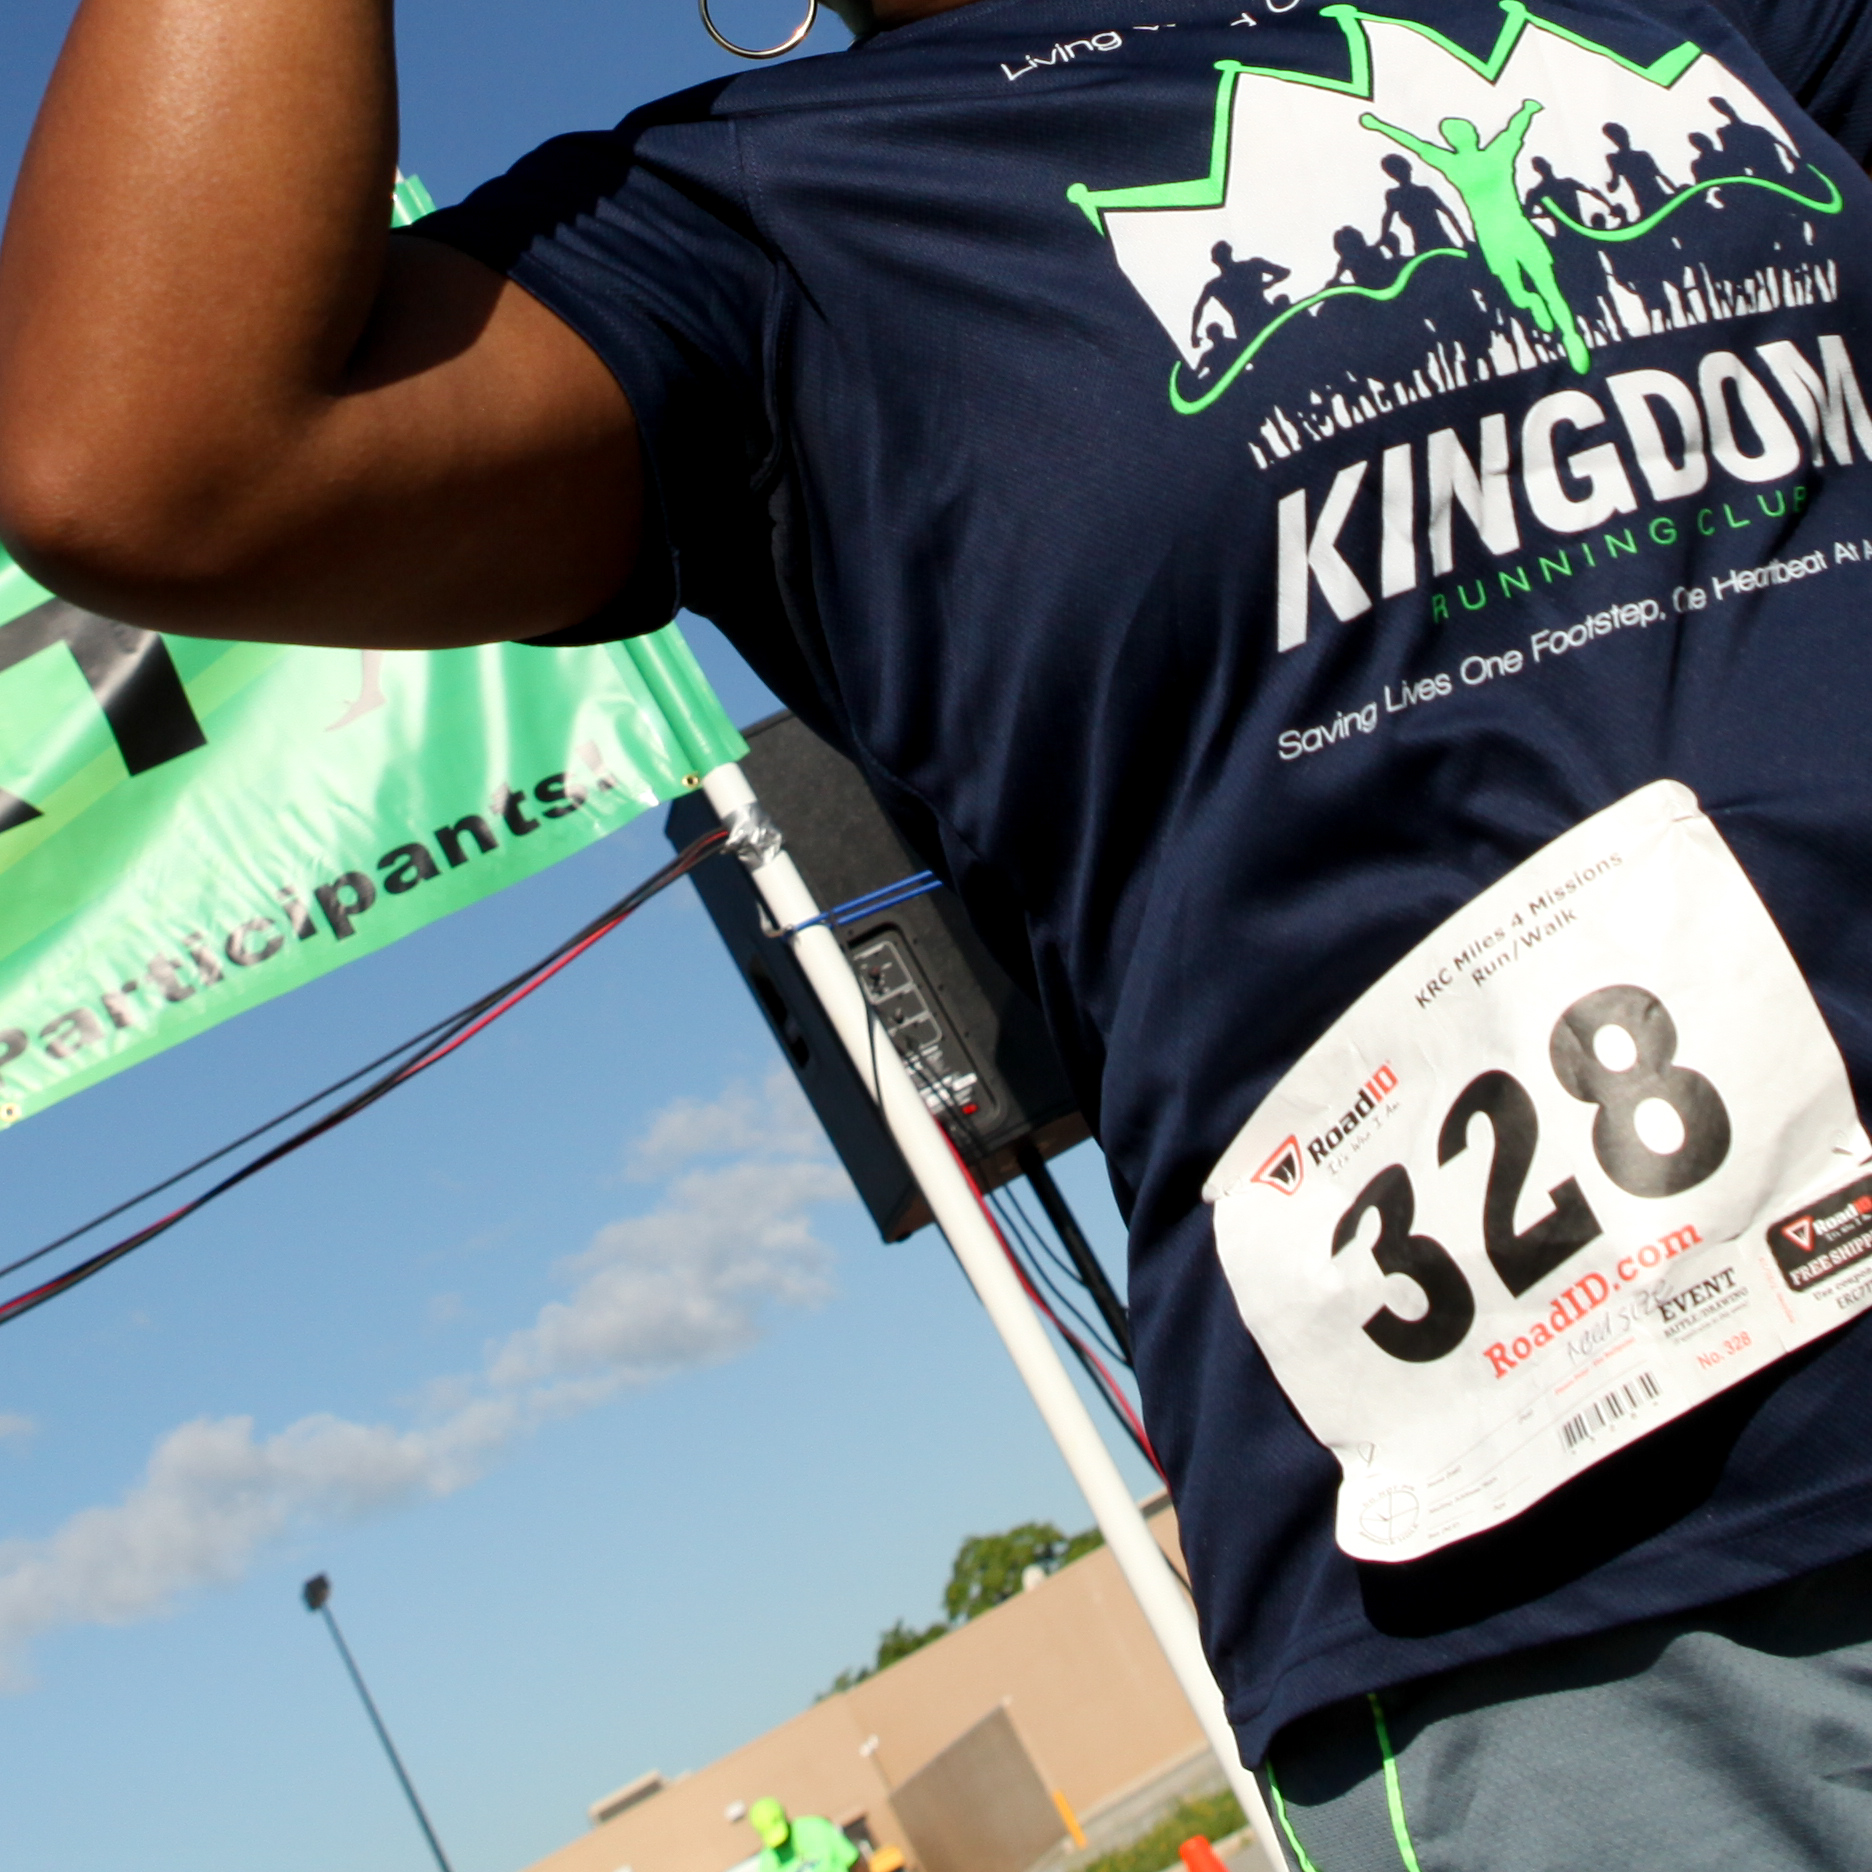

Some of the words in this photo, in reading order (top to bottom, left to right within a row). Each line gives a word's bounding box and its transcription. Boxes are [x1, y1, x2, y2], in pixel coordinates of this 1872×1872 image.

[999, 29, 1123, 82] Living
[1431, 517, 1678, 624] RUNNING
[1278, 701, 1378, 761] Saving
[1384, 671, 1452, 714] Lives
[1459, 649, 1524, 687] One
[1833, 541, 1861, 565] At
[1414, 967, 1454, 1010] KRC
[1453, 927, 1506, 972] Miles
[1511, 912, 1524, 928] 4
[1528, 851, 1624, 917] Missions
[1471, 907, 1579, 988] Run/Walk
[1306, 1063, 1400, 1167] RoadID
[1331, 983, 1732, 1364] 328
[1483, 1224, 1704, 1380] RoadID.com
[1658, 1266, 1737, 1324] EVENT
[1789, 1253, 1833, 1287] FREE
[1695, 1348, 1725, 1371] No.
[1721, 1330, 1753, 1357] 328
